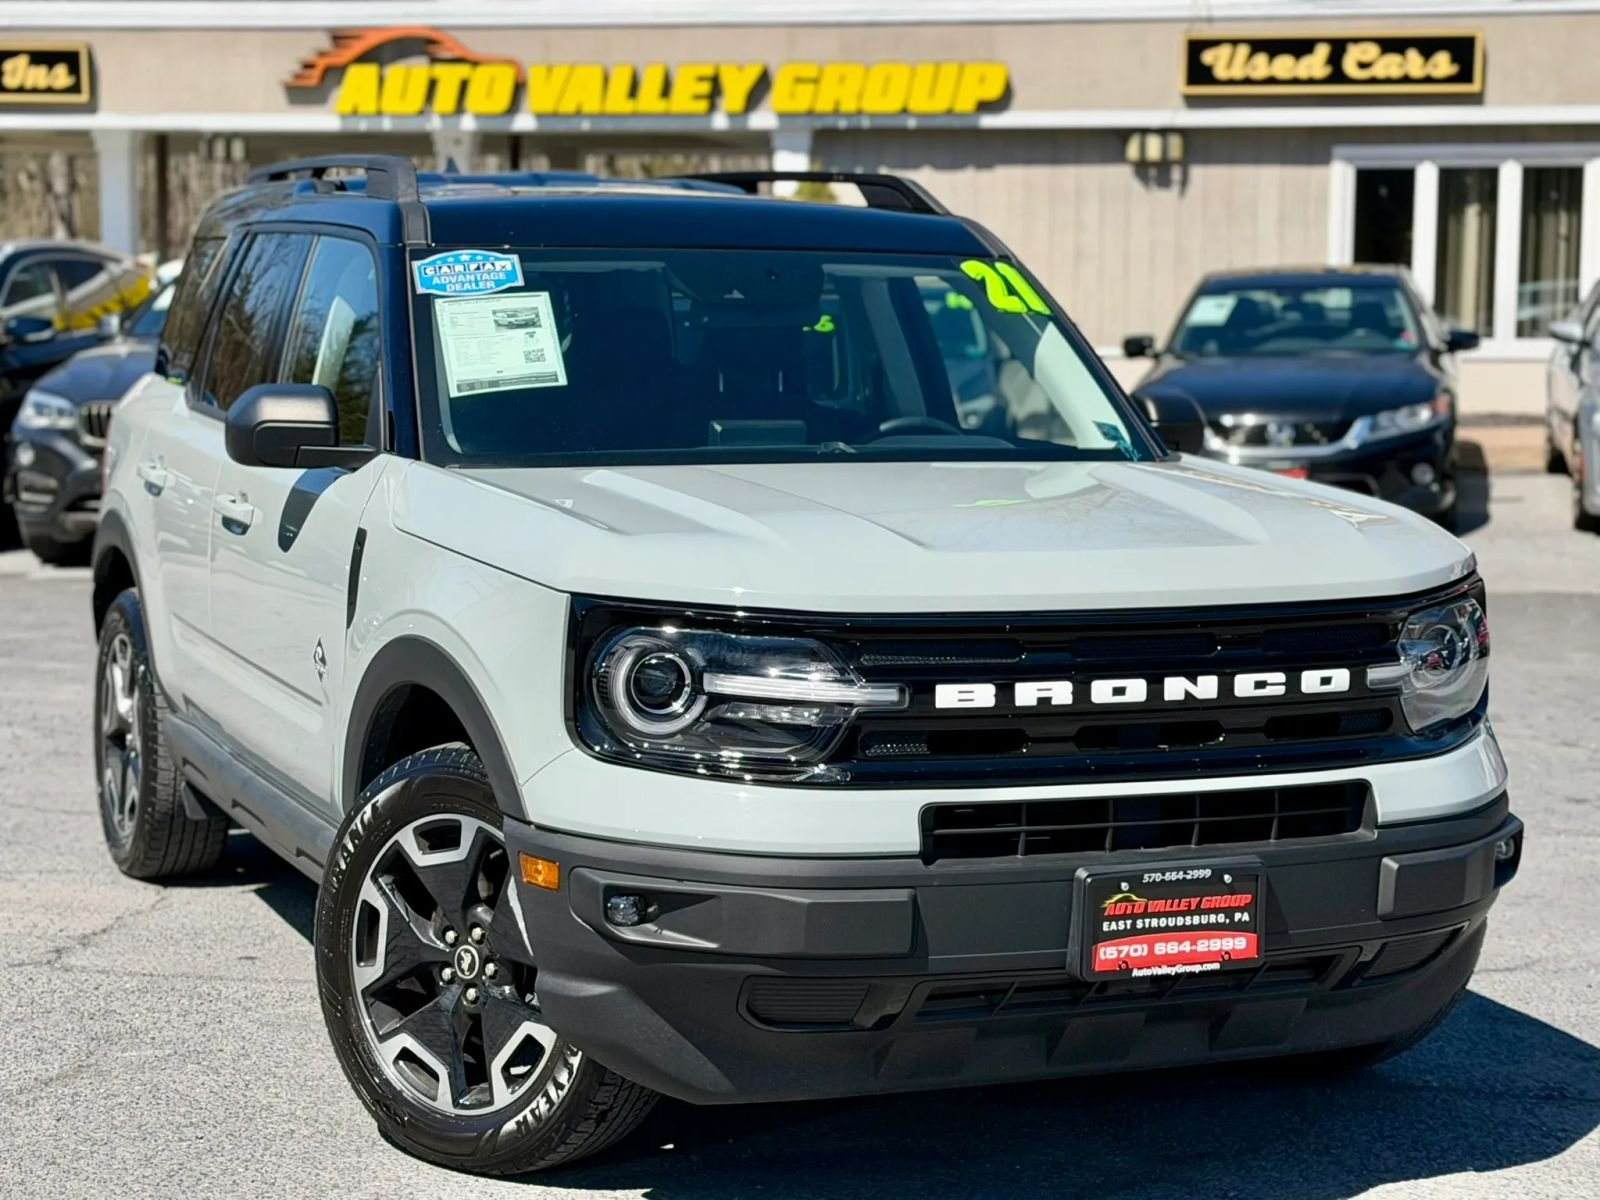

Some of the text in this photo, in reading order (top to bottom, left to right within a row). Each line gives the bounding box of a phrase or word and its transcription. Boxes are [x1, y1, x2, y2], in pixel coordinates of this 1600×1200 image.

[1200, 41, 1460, 81] Used Cars
[335, 63, 1008, 115] AUTO VALLEY GROUP
[423, 261, 512, 276] CARFAX
[432, 271, 507, 285] ADVANTAGE
[446, 282, 496, 292] DEALER
[960, 260, 1053, 315] 21
[935, 668, 1350, 709] BRONCO
[1142, 869, 1212, 883] 570-664-2999
[1104, 894, 1252, 917] AUTO VALLEY GROUP
[1102, 912, 1250, 932] EAST STROUDSBURG, PA
[1100, 937, 1247, 960] (570) 664-2999
[1132, 962, 1220, 978] AutoValleyGroup.com
